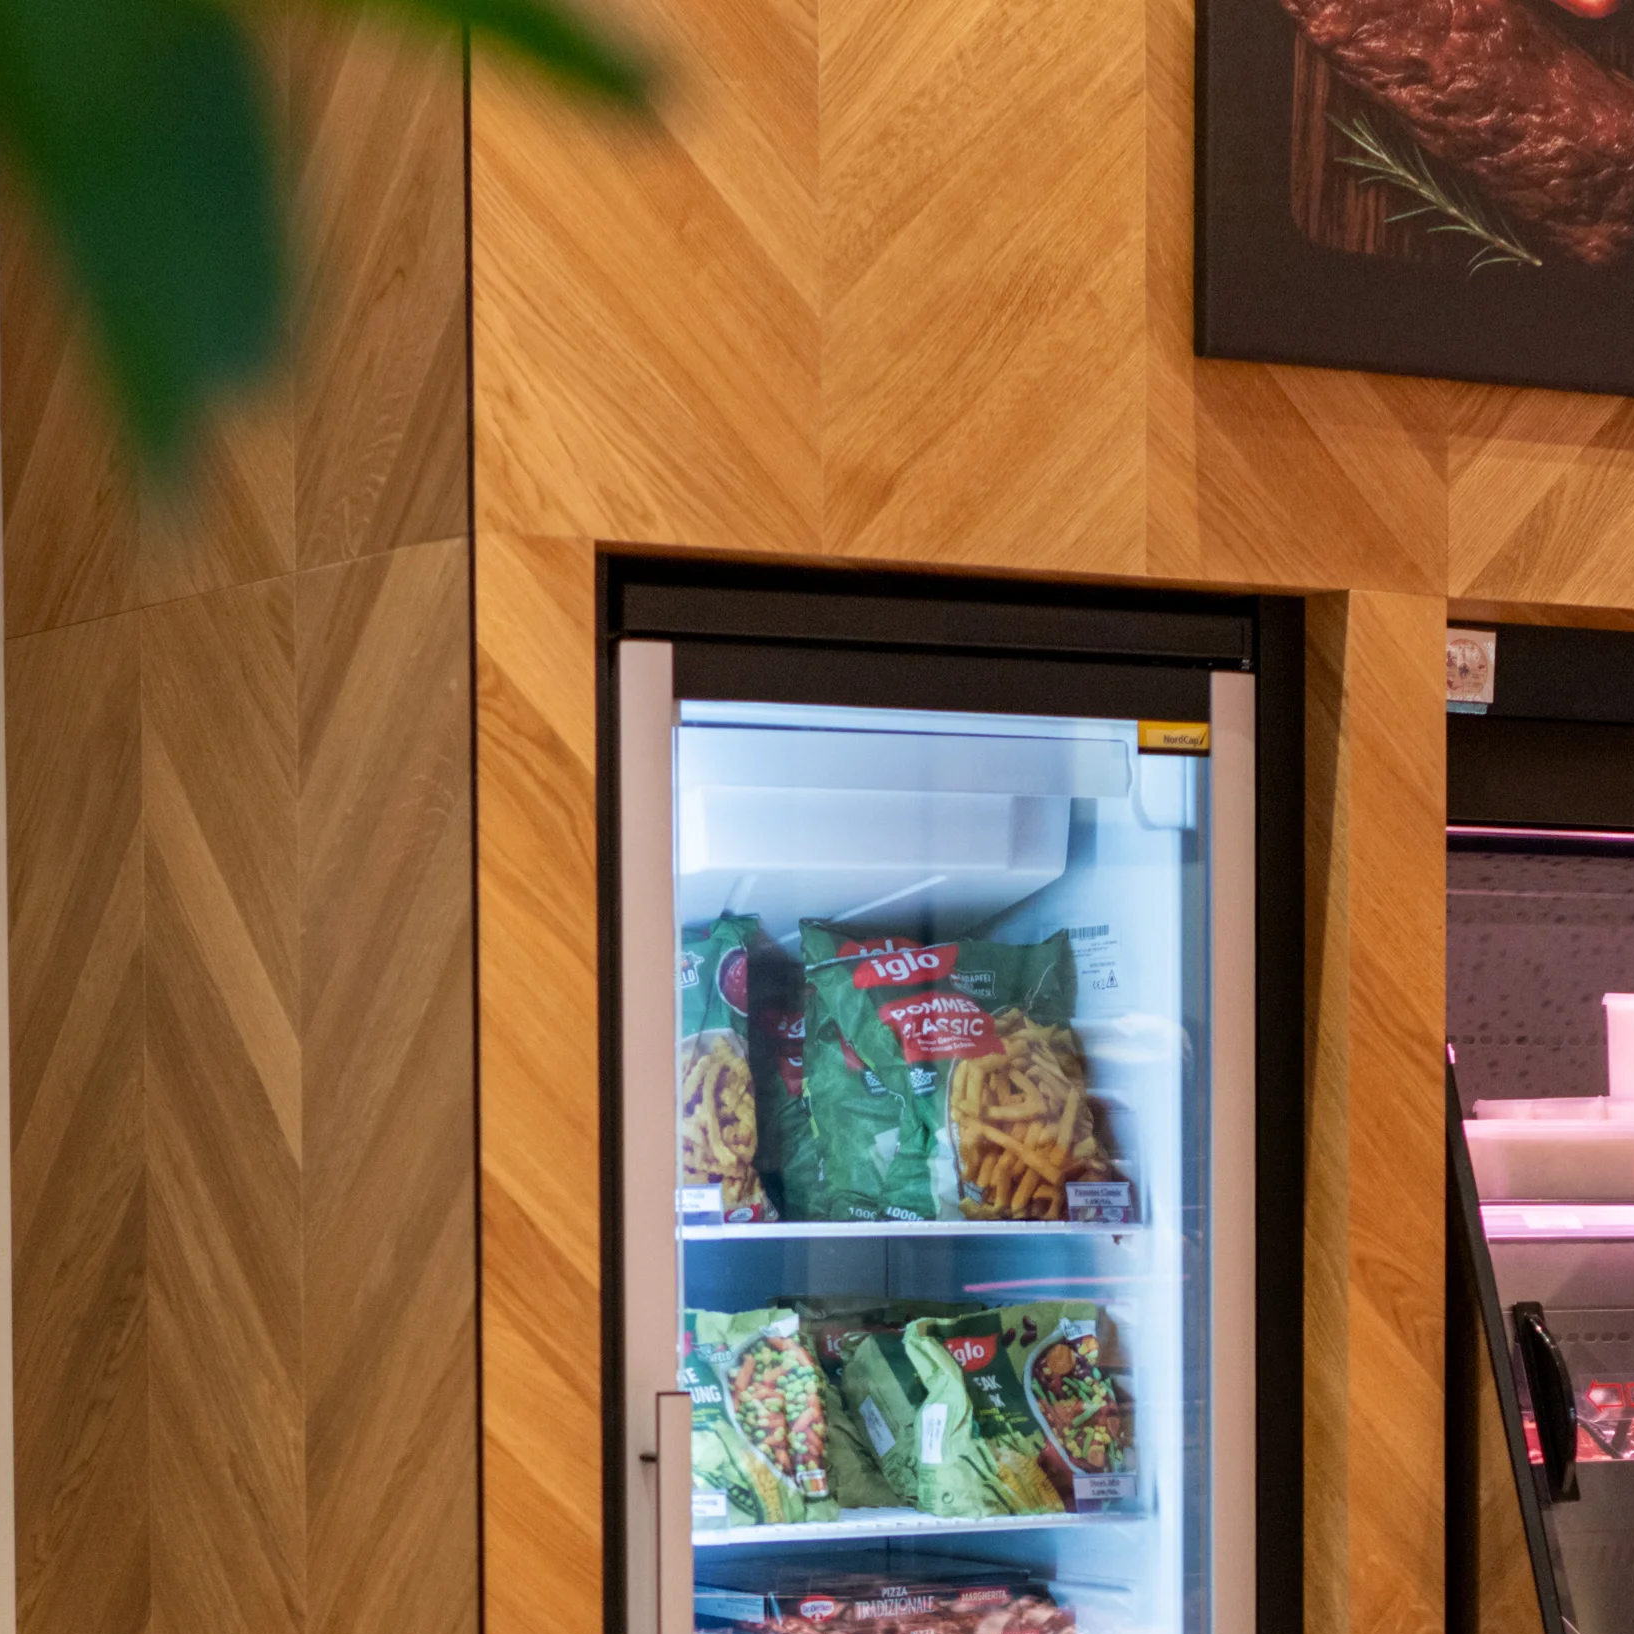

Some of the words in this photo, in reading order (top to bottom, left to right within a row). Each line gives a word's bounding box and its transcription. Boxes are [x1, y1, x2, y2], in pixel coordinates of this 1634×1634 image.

[1163, 734, 1199, 747] NordCap
[871, 953, 940, 981] iglo
[890, 998, 980, 1021] POMMES
[902, 1018, 985, 1038] CLASSIC
[882, 1587, 908, 1598] PIZZA
[961, 1590, 1008, 1602] MARGHERITA
[855, 1596, 935, 1619] TRADIZIONALE
